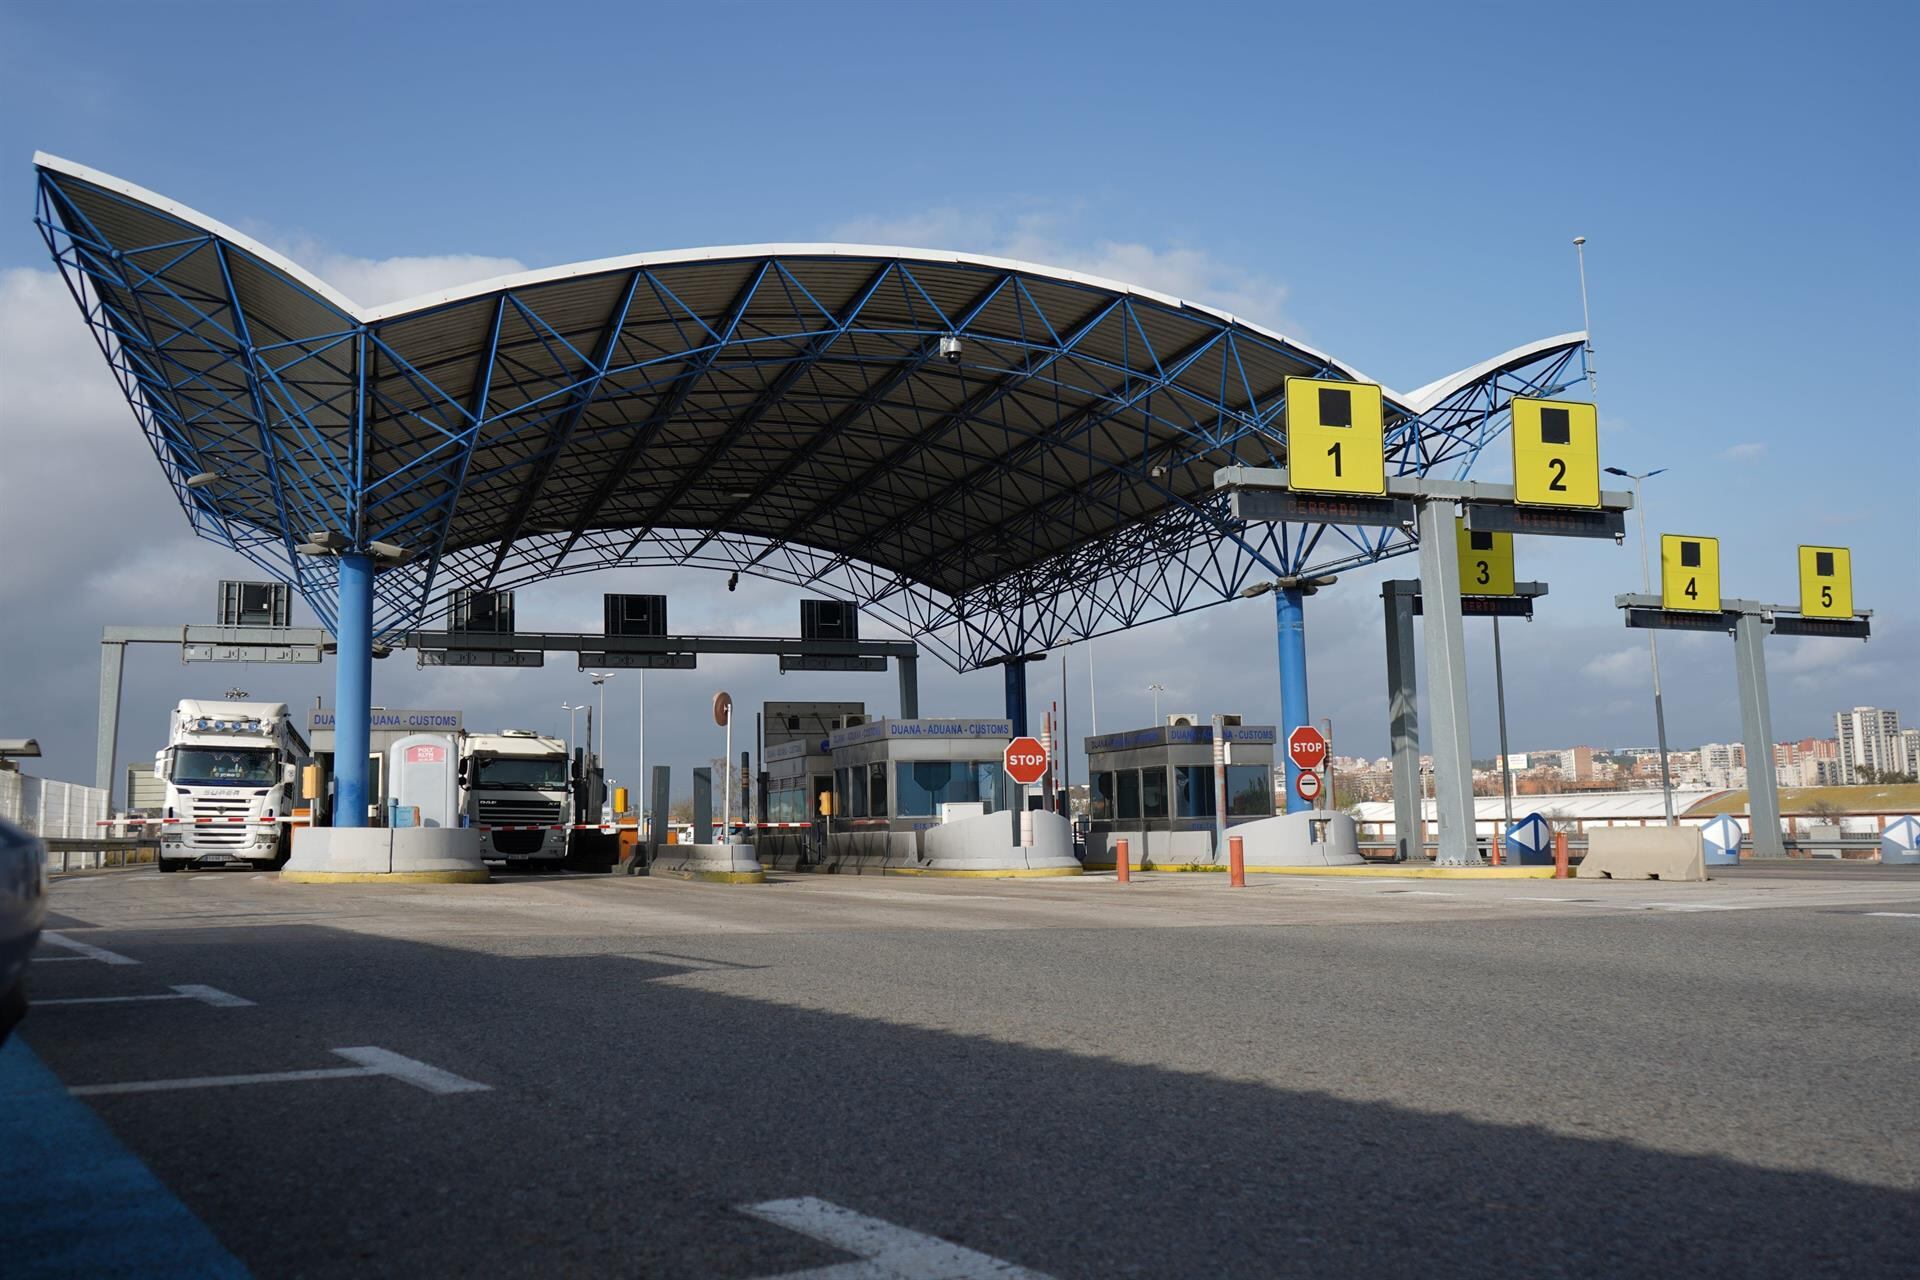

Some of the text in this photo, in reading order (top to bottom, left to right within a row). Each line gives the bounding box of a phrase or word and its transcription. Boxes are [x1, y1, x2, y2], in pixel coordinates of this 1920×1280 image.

[1328, 442, 1341, 477] 1
[1549, 458, 1566, 492] 2
[1476, 561, 1490, 585] 3
[1685, 577, 1698, 601] 4
[1821, 586, 1833, 608] 5
[314, 714, 335, 725] DUA
[408, 715, 457, 727] CUSTOMS
[891, 724, 921, 735] DUANA
[927, 724, 963, 735] ADUANA
[969, 724, 1009, 735] CUSTOMS
[1239, 729, 1273, 740] CUSTOMS
[1293, 742, 1322, 753] STOP
[1009, 754, 1044, 766] STOP
